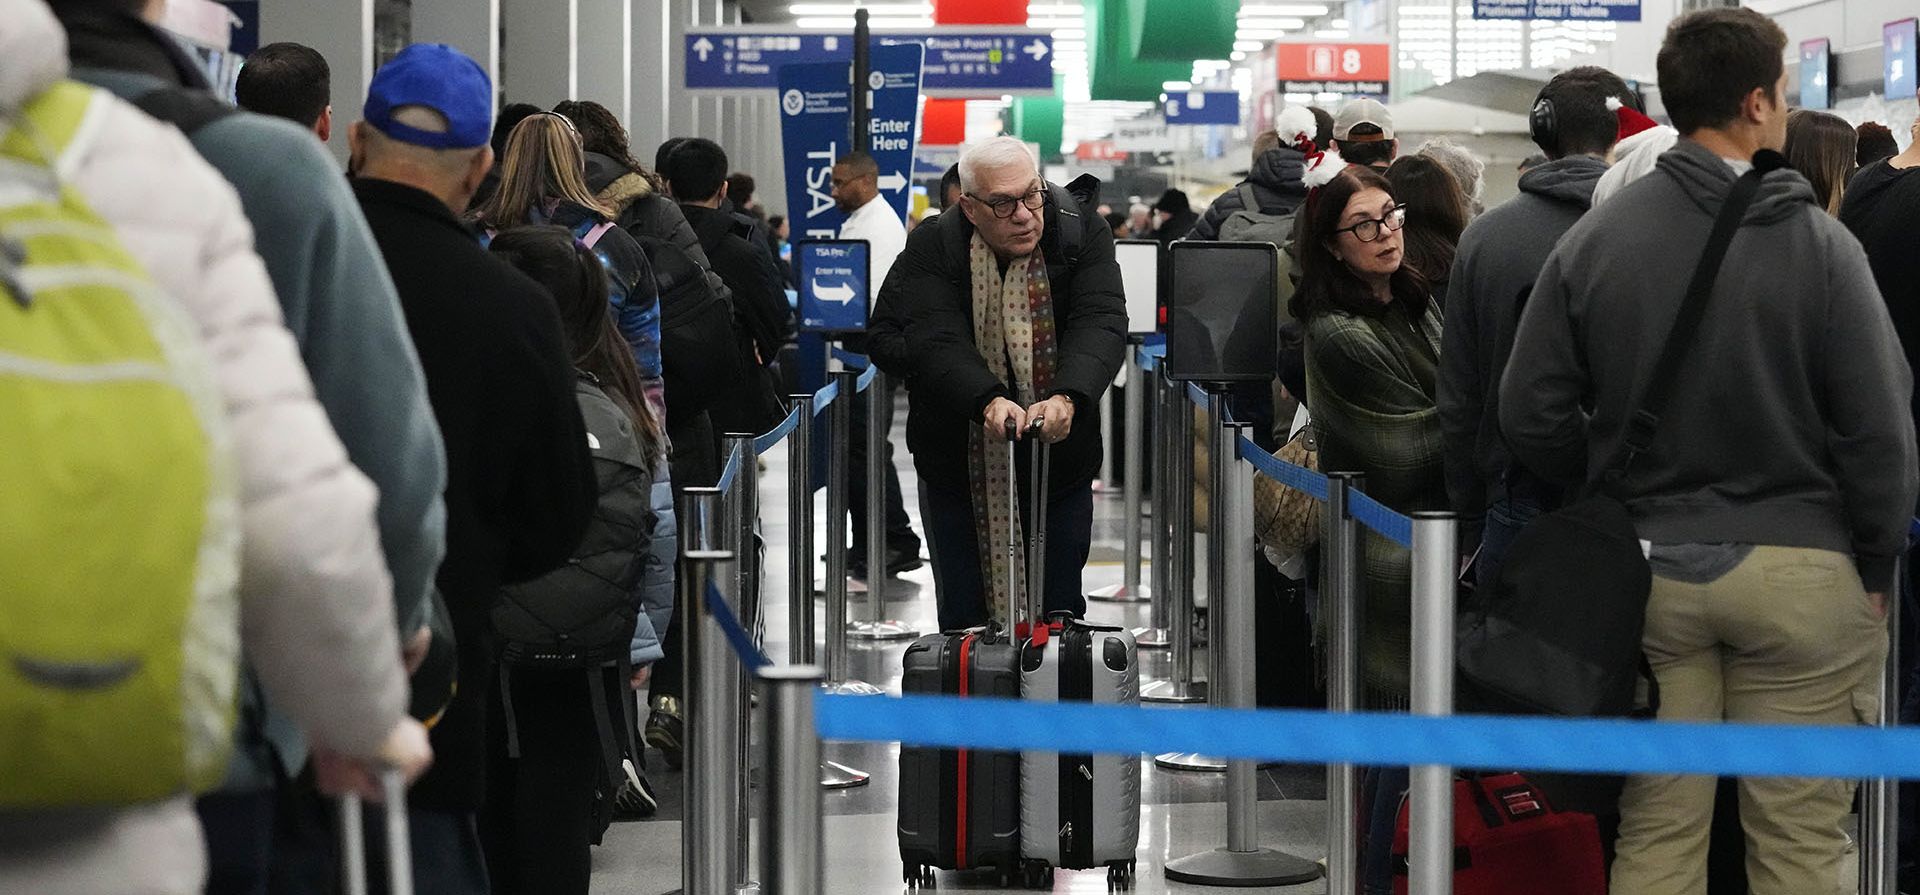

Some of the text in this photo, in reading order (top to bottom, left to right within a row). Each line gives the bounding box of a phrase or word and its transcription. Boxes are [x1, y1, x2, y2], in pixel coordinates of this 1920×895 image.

[1342, 48, 1361, 74] 8
[871, 118, 911, 133] Enter
[872, 135, 908, 150] Here
[806, 141, 836, 218] TSA
[815, 248, 829, 256] TSA
